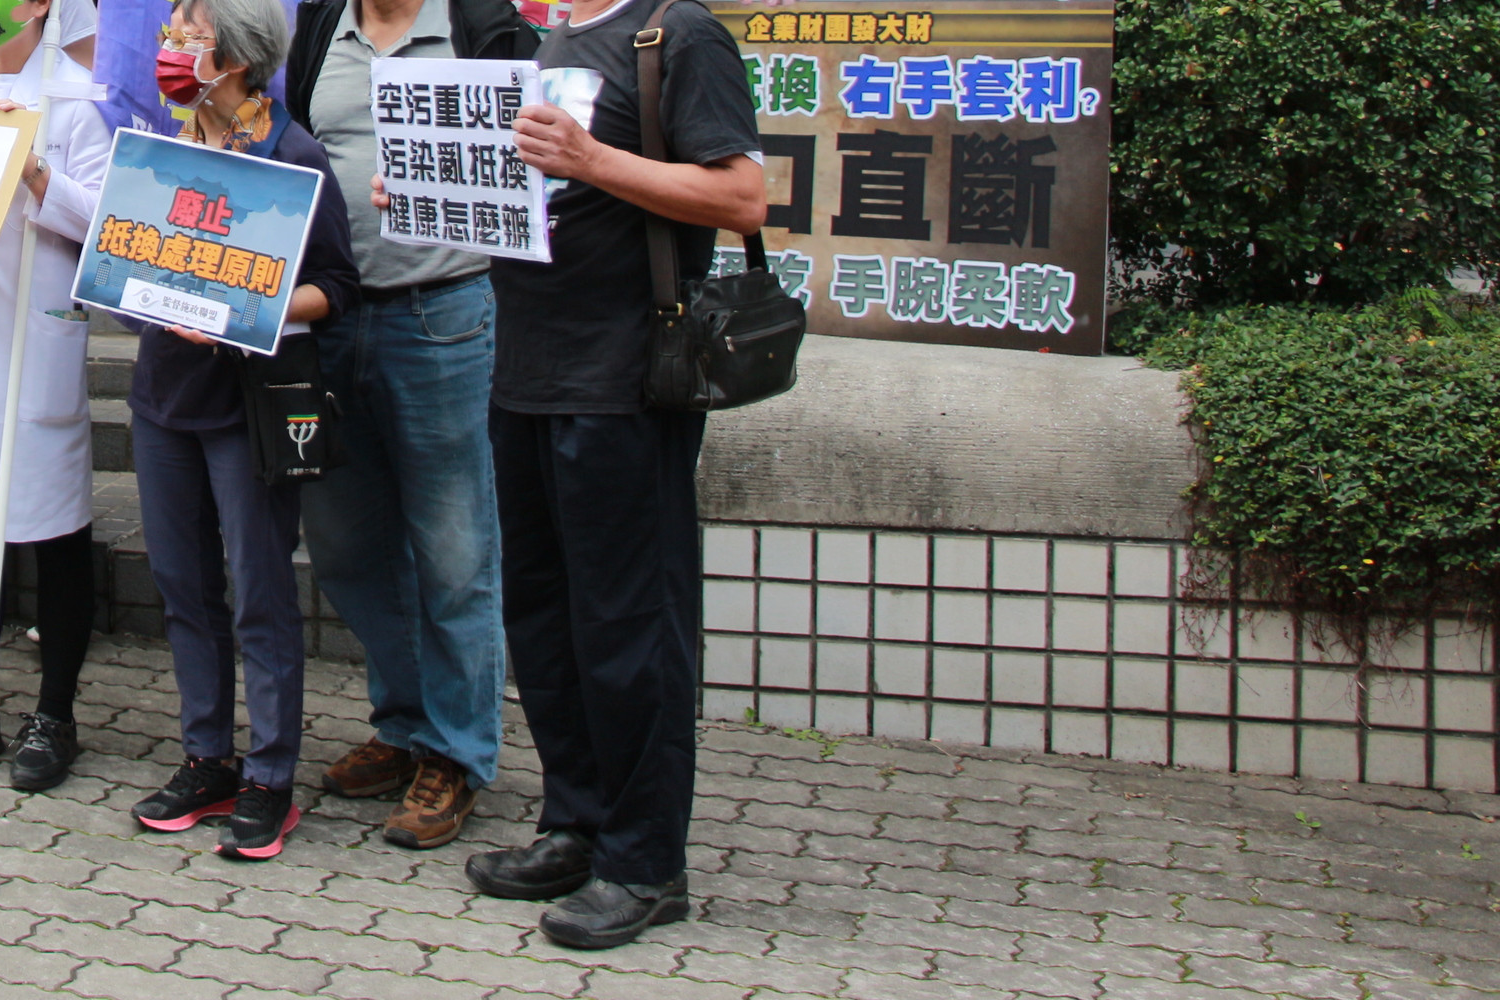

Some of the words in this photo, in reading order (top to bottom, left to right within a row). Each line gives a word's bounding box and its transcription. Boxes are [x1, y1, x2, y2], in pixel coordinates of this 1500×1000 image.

[746, 12, 933, 43] 企業財團發大財
[377, 82, 523, 130] 空污重災區
[380, 136, 528, 191] 污染亂抵換
[166, 186, 233, 236] 廢止
[96, 214, 287, 298] 抵換處理原則
[161, 296, 218, 321] 監督施政聯盟
[830, 253, 1074, 334] 手腕柔軟
